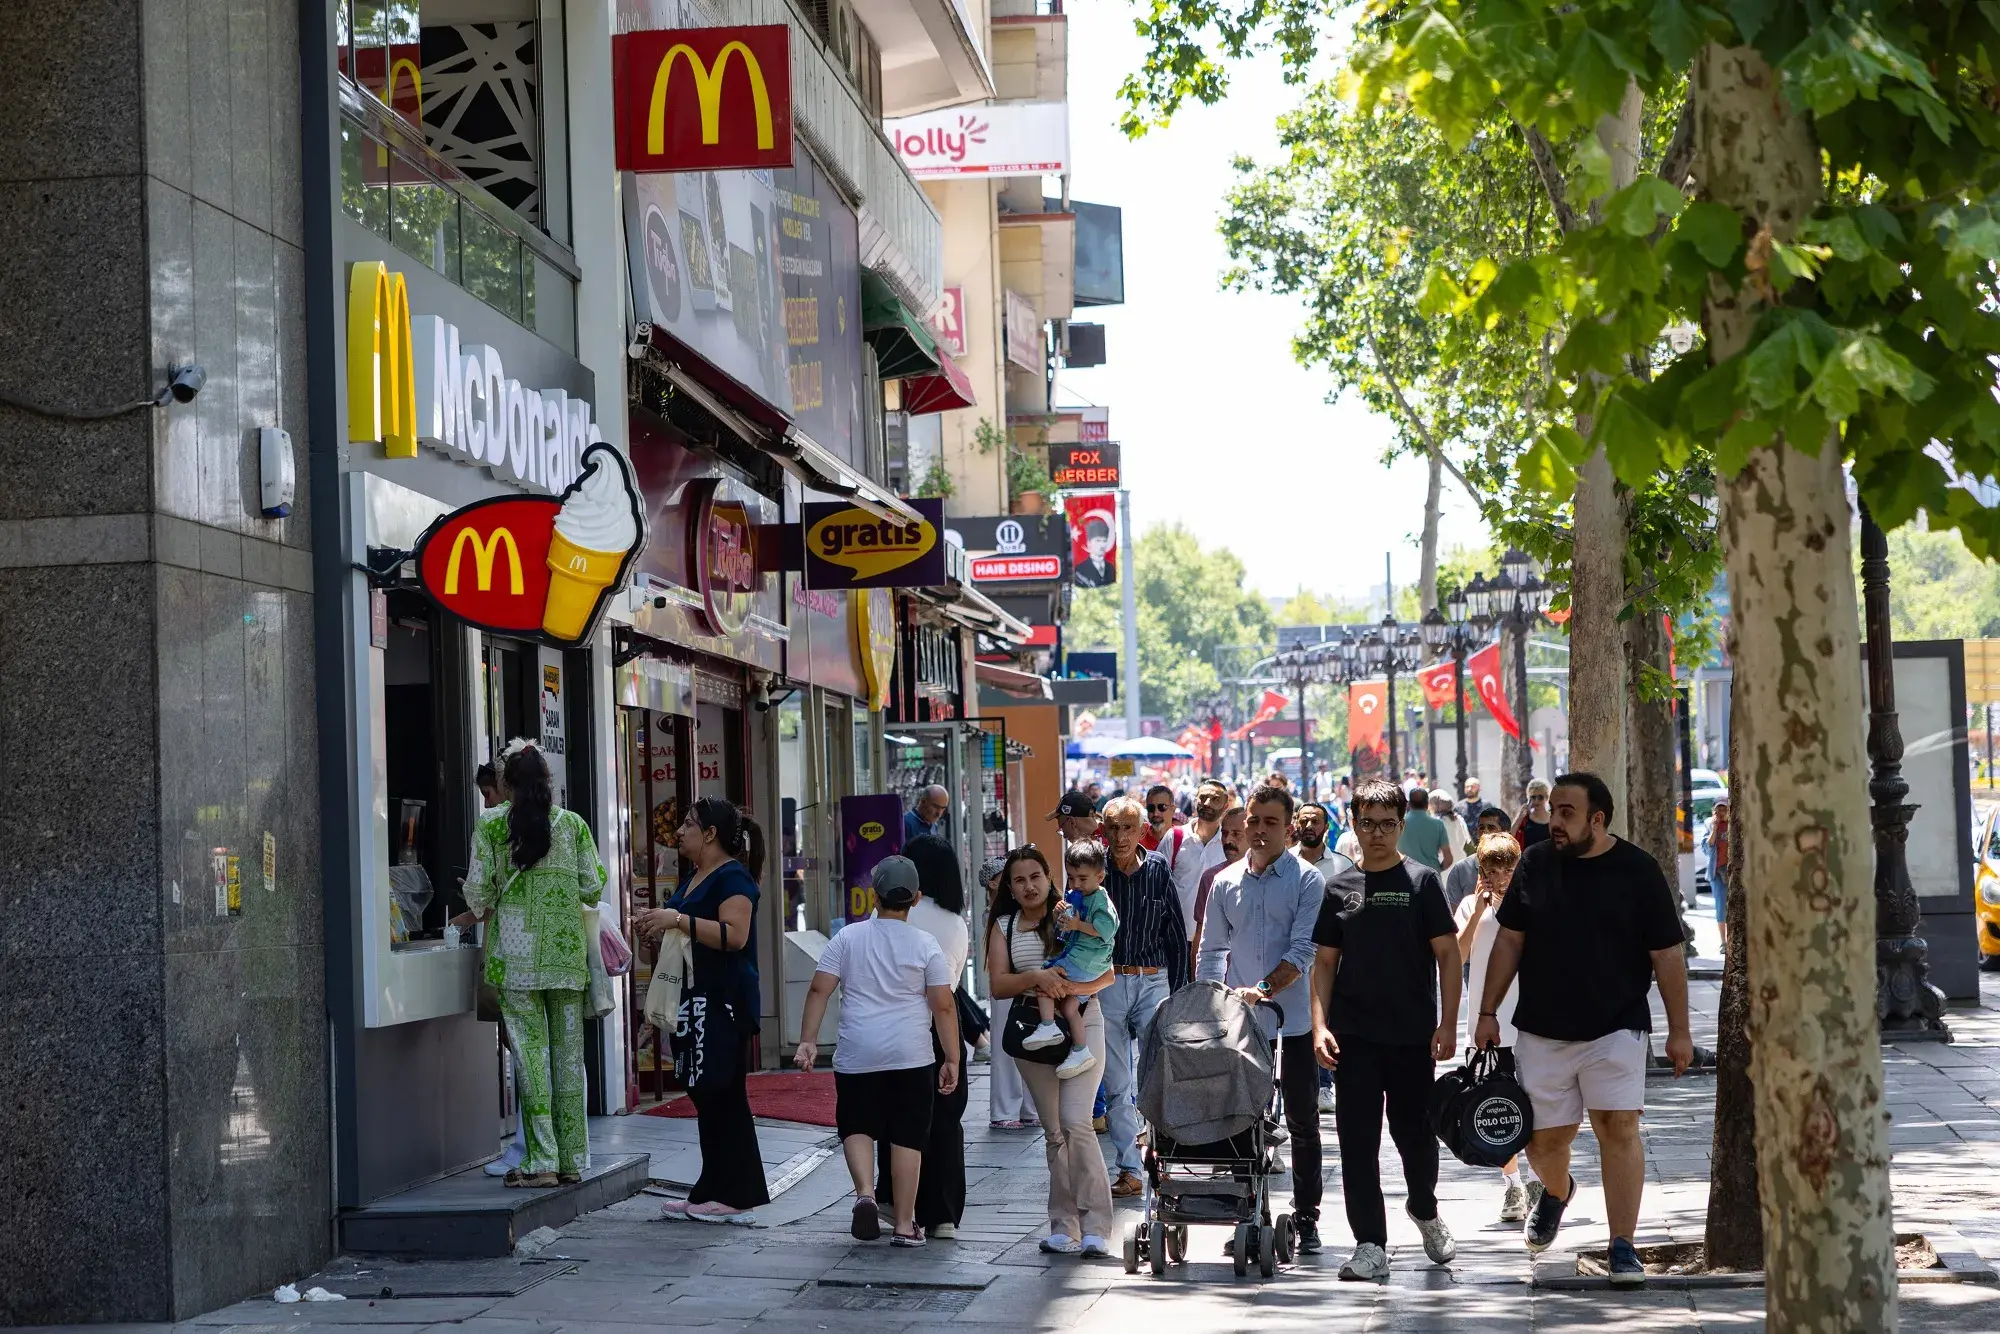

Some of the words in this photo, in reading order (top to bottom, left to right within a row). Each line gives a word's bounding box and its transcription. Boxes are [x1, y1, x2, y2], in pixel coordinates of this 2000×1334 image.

[432, 313, 603, 496] McDonald'
[1069, 450, 1101, 465] FOX
[820, 519, 922, 556] gratis
[975, 563, 1006, 576] HAIR
[1008, 562, 1056, 574] DESING
[862, 824, 882, 836] gratis
[693, 996, 707, 1082] YUKARI
[1486, 1106, 1508, 1114] original
[1477, 1119, 1498, 1127] POLO
[1499, 1116, 1520, 1125] CLUB
